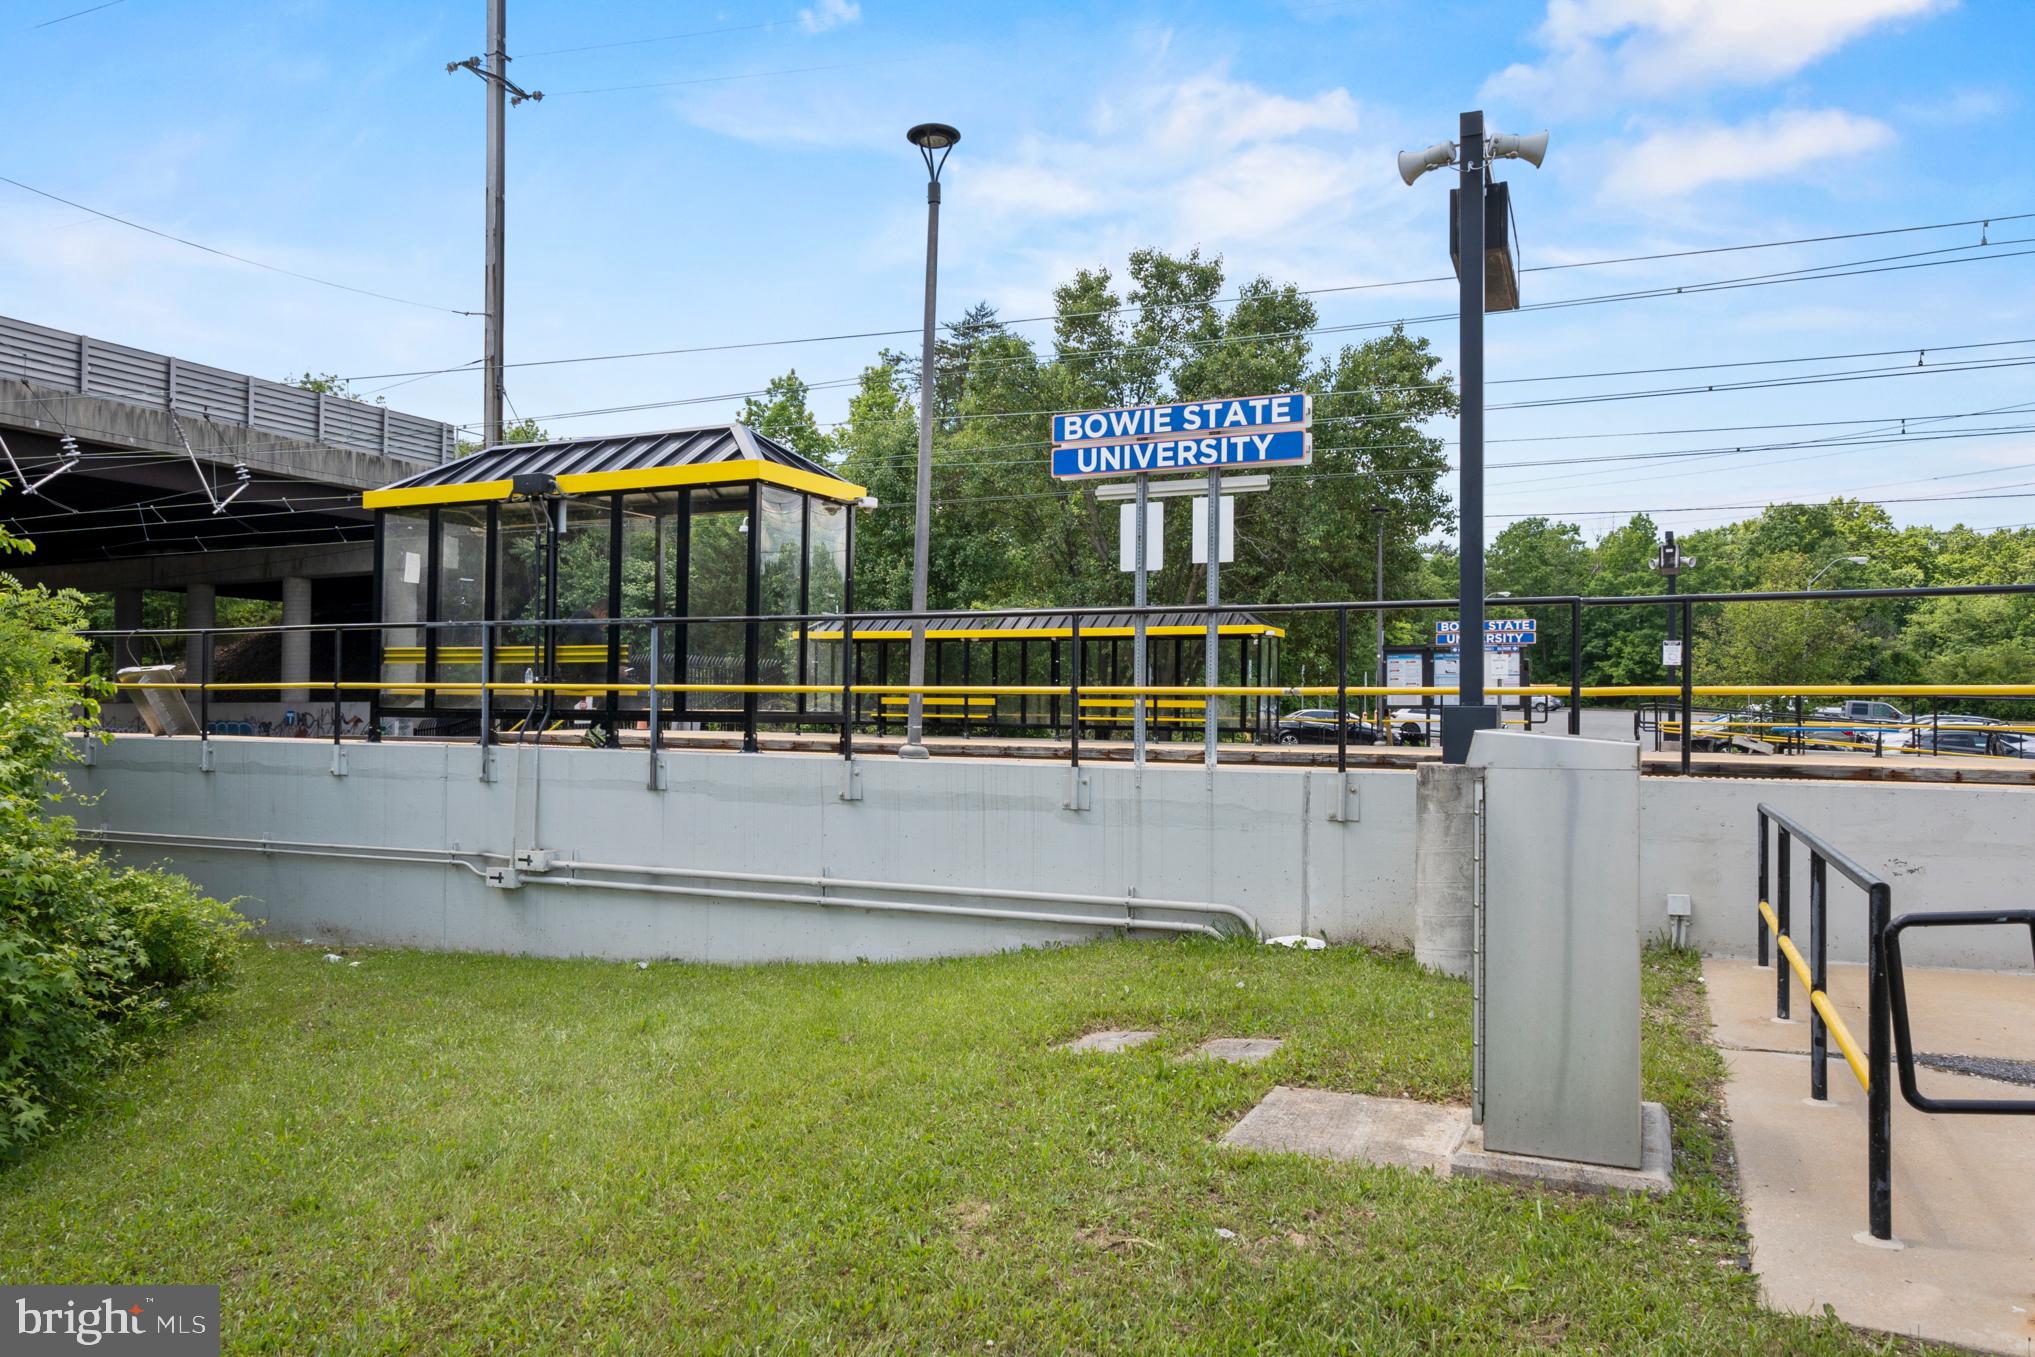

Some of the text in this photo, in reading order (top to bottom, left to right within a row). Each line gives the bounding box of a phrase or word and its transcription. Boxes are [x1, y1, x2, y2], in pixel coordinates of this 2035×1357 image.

[1064, 397, 1291, 440] BOWIE STATE
[1077, 434, 1274, 473] UNIVERSITY
[1488, 620, 1530, 630] STATE
